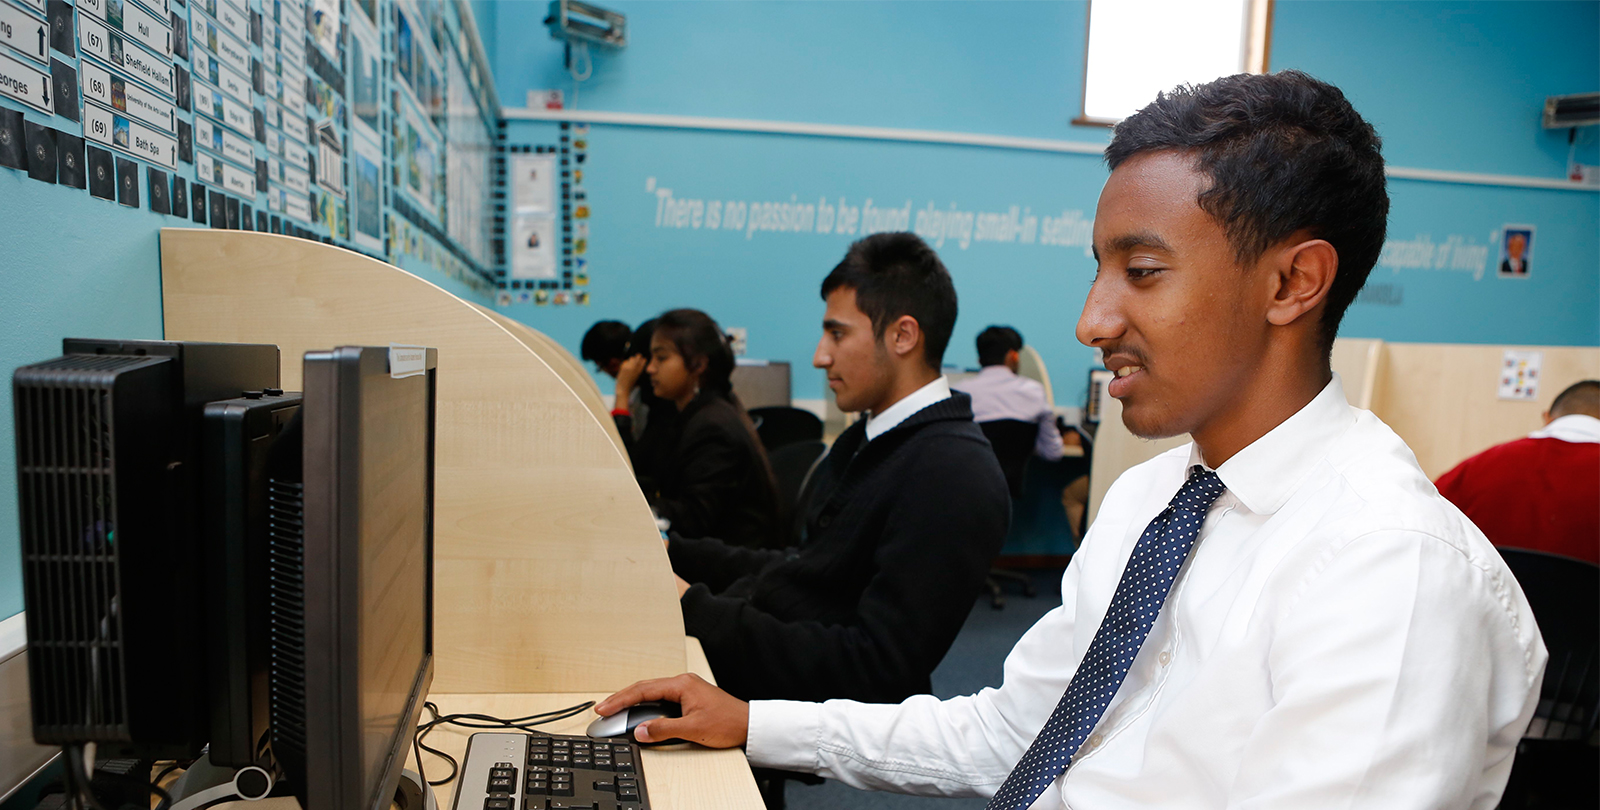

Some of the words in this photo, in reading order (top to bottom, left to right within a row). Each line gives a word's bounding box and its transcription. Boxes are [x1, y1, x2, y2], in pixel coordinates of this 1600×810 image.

[138, 22, 149, 38] Hull
[87, 31, 103, 52] (67)
[125, 53, 151, 77] Sheffield
[151, 68, 169, 87] Hallam
[89, 77, 105, 97] (68)
[126, 93, 143, 108] University
[91, 119, 107, 137] (69)
[135, 136, 148, 151] Bath
[149, 144, 160, 155] Spa
[705, 199, 722, 230] is
[723, 200, 747, 231] no
[746, 193, 815, 240] passion
[816, 196, 835, 234] to
[836, 196, 860, 235] be
